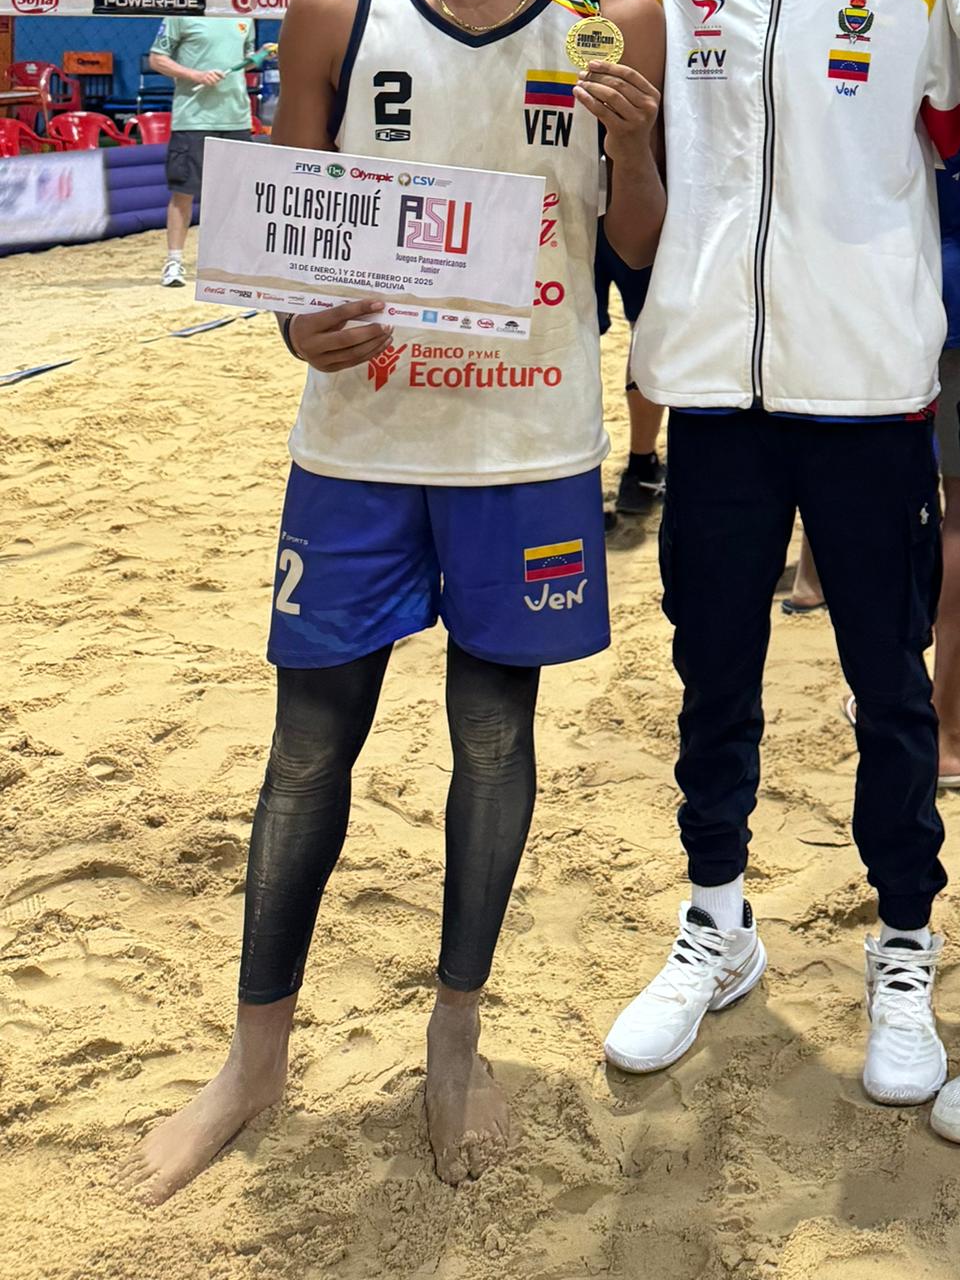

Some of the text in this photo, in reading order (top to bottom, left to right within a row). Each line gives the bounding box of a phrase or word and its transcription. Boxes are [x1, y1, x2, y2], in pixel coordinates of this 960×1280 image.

[687, 49, 727, 69] FVV
[373, 71, 413, 126] 2
[524, 108, 574, 148] VEN
[295, 162, 322, 173] FIVB
[350, 167, 394, 184] Olympic
[412, 175, 436, 186] CSV
[255, 181, 382, 228] YO CLASIFIQUÉ
[265, 221, 353, 262] A MI PAÍS
[289, 262, 298, 270] 31
[298, 263, 309, 272] DE
[349, 269, 356, 277] 2
[356, 270, 367, 278] DE
[367, 272, 402, 283] FEBRERO
[402, 276, 413, 284] DE
[413, 277, 434, 286] 2025
[374, 279, 406, 291] BOLIVIA
[411, 343, 501, 359] Banco PYME
[408, 361, 563, 389] Ecofuturo
[275, 548, 304, 616] 2
